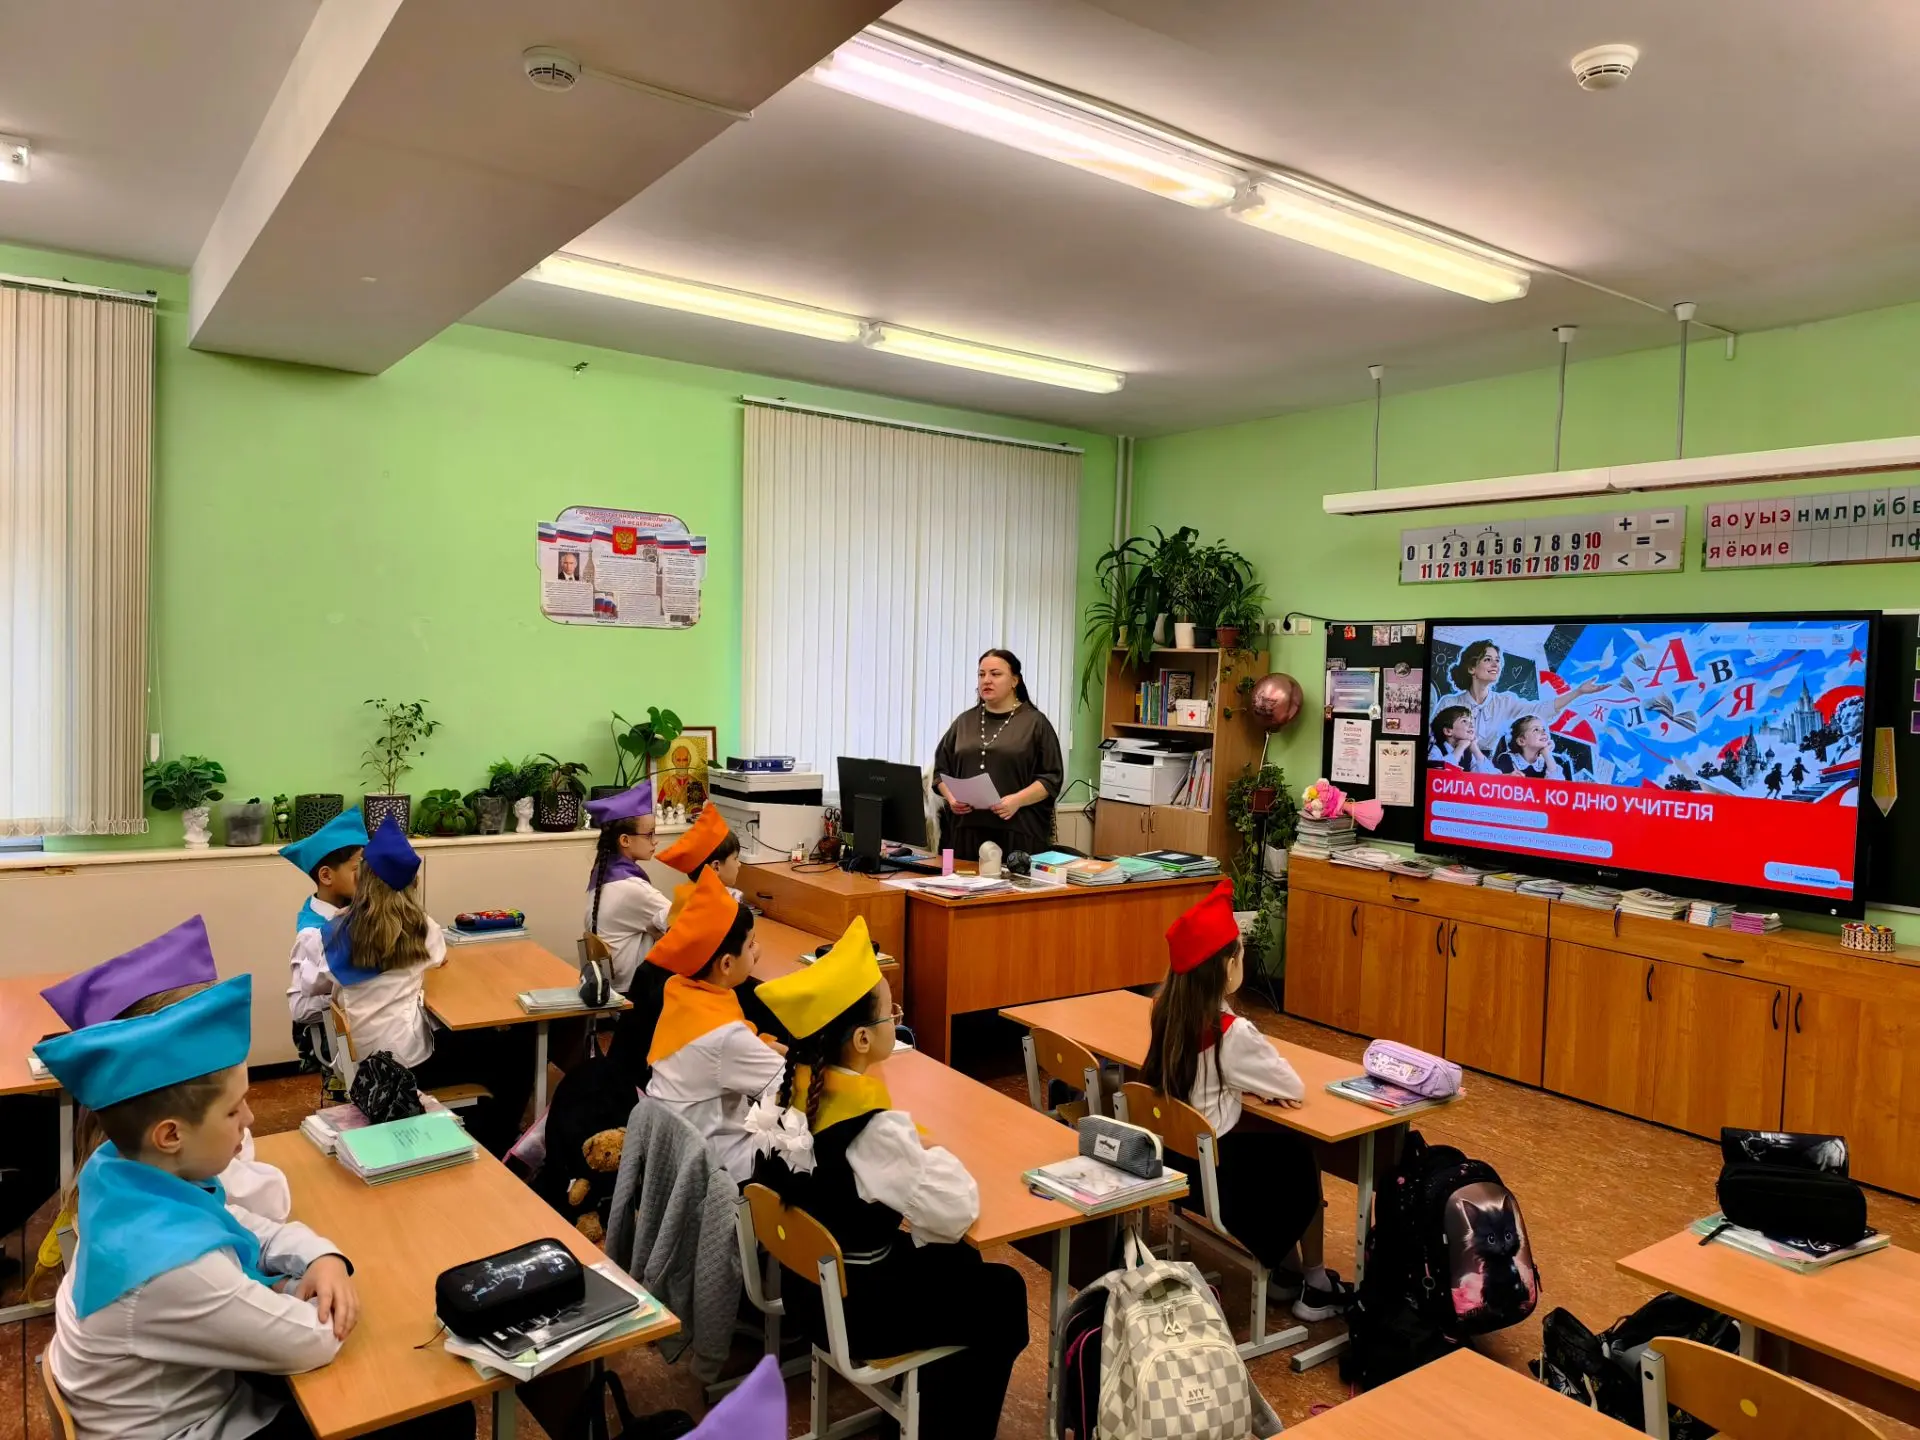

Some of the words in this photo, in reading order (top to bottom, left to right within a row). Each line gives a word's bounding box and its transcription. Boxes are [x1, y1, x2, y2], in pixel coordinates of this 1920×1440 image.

[1407, 546, 1414, 560] 0
[1428, 544, 1433, 559] 1
[1442, 543, 1450, 559] 2
[1460, 541, 1468, 557] 3
[1476, 540, 1484, 556] 4
[1495, 539, 1502, 554] 5
[1513, 537, 1522, 553] 6
[1534, 536, 1541, 552] 7
[1552, 534, 1560, 550] 8
[1572, 534, 1580, 549] 9
[1585, 532, 1601, 548] 10
[1421, 564, 1432, 578] 11
[1437, 562, 1449, 578] 12
[1454, 561, 1466, 576] 13
[1470, 560, 1484, 576] 14
[1488, 560, 1502, 574] 15
[1506, 558, 1521, 573] 16
[1526, 557, 1540, 572] 17
[1544, 556, 1559, 572] 18
[1564, 554, 1579, 570] 19
[1583, 553, 1600, 570] 20
[1432, 778, 1475, 797] СИЛА
[1479, 784, 1540, 804] СЛОВА.
[1545, 788, 1568, 806] КО
[1572, 792, 1618, 812] ДНЮ
[1622, 796, 1713, 822] УЧИТЕЛЯ
[1189, 1388, 1204, 1397] AYY
